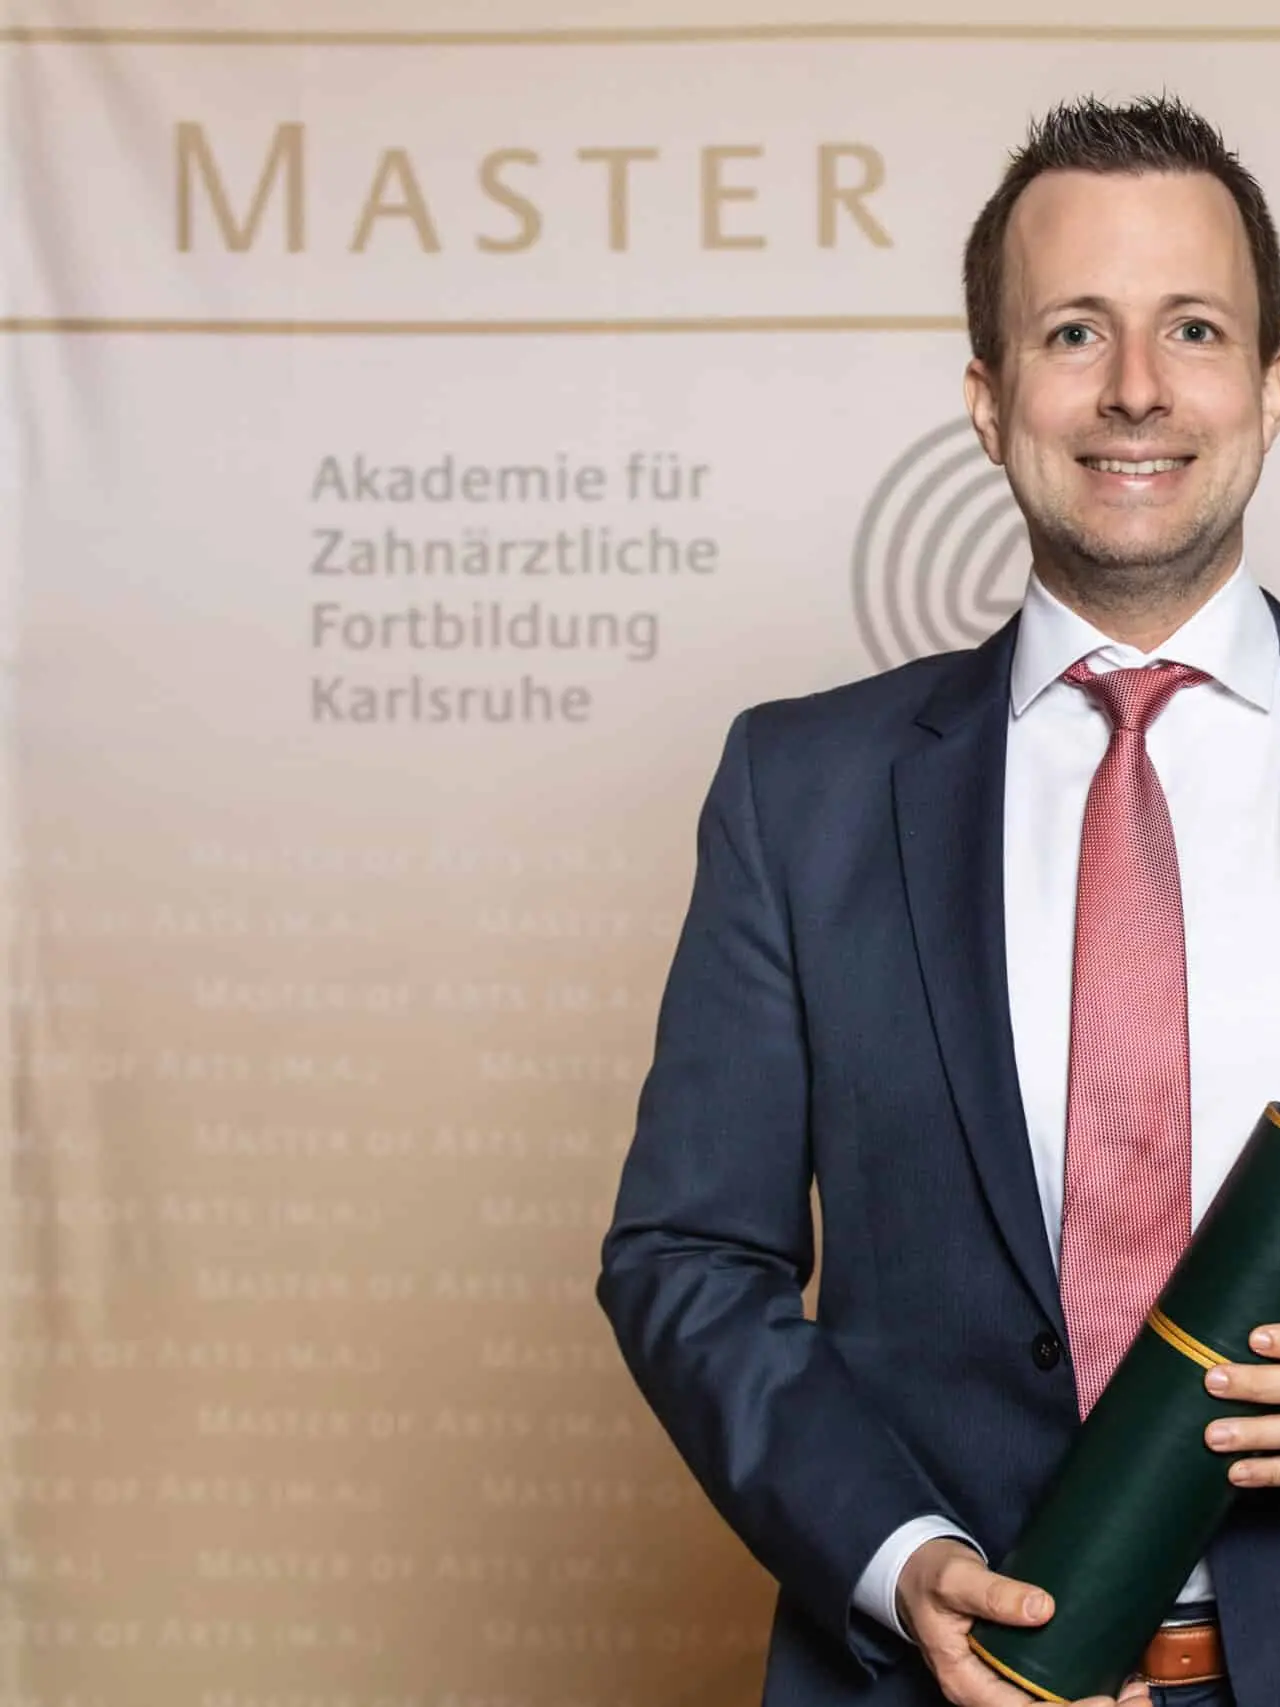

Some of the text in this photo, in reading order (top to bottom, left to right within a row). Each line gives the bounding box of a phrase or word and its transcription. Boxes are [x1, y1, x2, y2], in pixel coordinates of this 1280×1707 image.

[172, 121, 895, 255] MASTER
[311, 453, 711, 502] Akademie für
[311, 527, 718, 577] Zahnärztliche
[311, 602, 660, 661] Fortbildung
[311, 675, 591, 723] Karlsruhe
